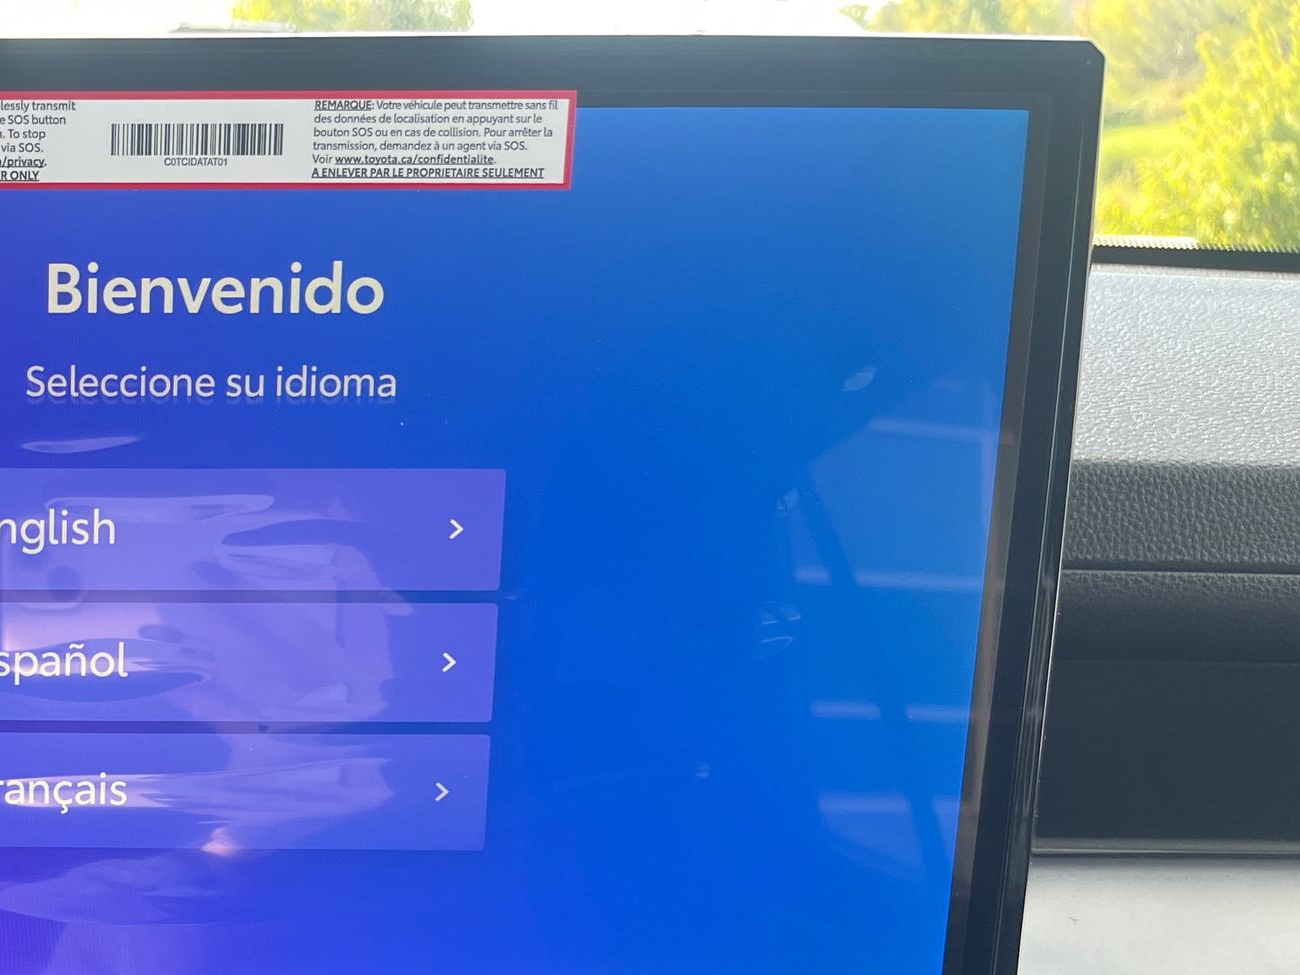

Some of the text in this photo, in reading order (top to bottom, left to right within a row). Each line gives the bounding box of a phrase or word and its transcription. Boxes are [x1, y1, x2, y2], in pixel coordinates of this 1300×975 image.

[32, 100, 76, 111] transmit
[314, 99, 558, 111] REMARQUE: Votre véhicule peut transmettre sans fil
[7, 114, 30, 125] SOS
[31, 114, 67, 125] button
[314, 113, 543, 126] des données de localisation en appuyant sur le
[7, 128, 20, 139] To
[22, 129, 46, 141] stop
[313, 127, 553, 137] bouton SOS ou en cas de collision. Pour arrêter la
[1, 142, 17, 153] via
[18, 142, 44, 153] SOS.
[312, 141, 528, 153] transmission, demandez à un agent via SOS.
[312, 154, 333, 164] Voir
[9, 170, 40, 182] ONLY
[311, 167, 545, 180] A ENLEVER PAR LE PROPRIETAIRE SEULEMENT
[45, 260, 386, 316] Bienvenido
[25, 364, 399, 400] Seleccione su idioma
